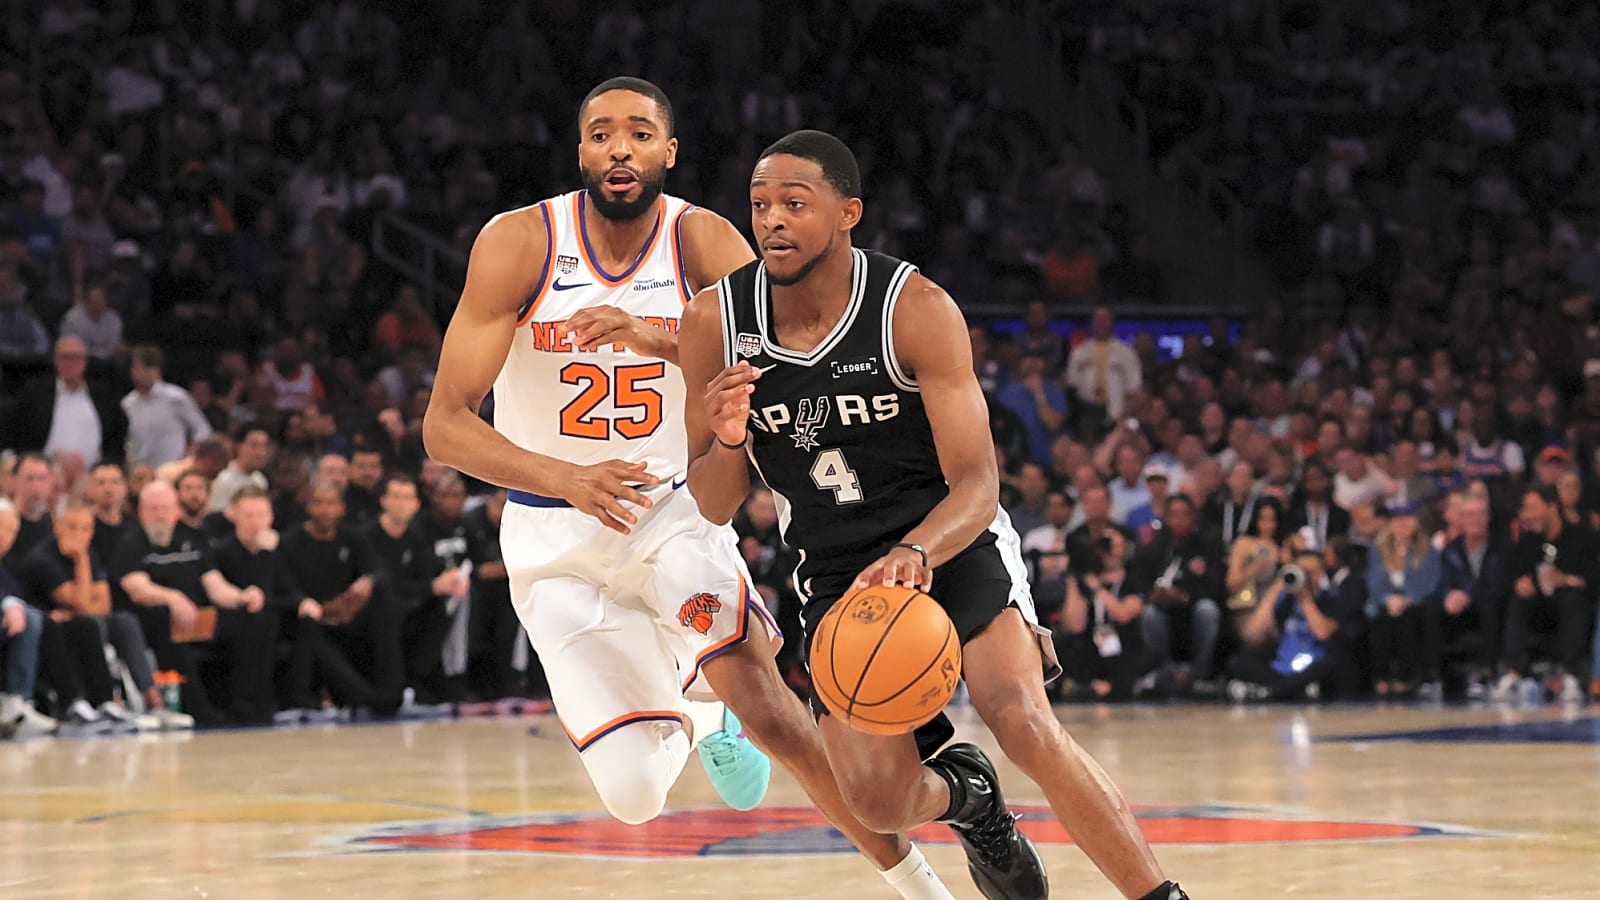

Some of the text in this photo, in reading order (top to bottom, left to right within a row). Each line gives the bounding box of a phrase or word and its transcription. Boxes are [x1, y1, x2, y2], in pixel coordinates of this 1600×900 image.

[558, 255, 577, 264] USA
[650, 278, 675, 289] dhabi
[837, 362, 872, 374] LEDGER
[560, 361, 665, 440] 25
[809, 448, 864, 505] 4
